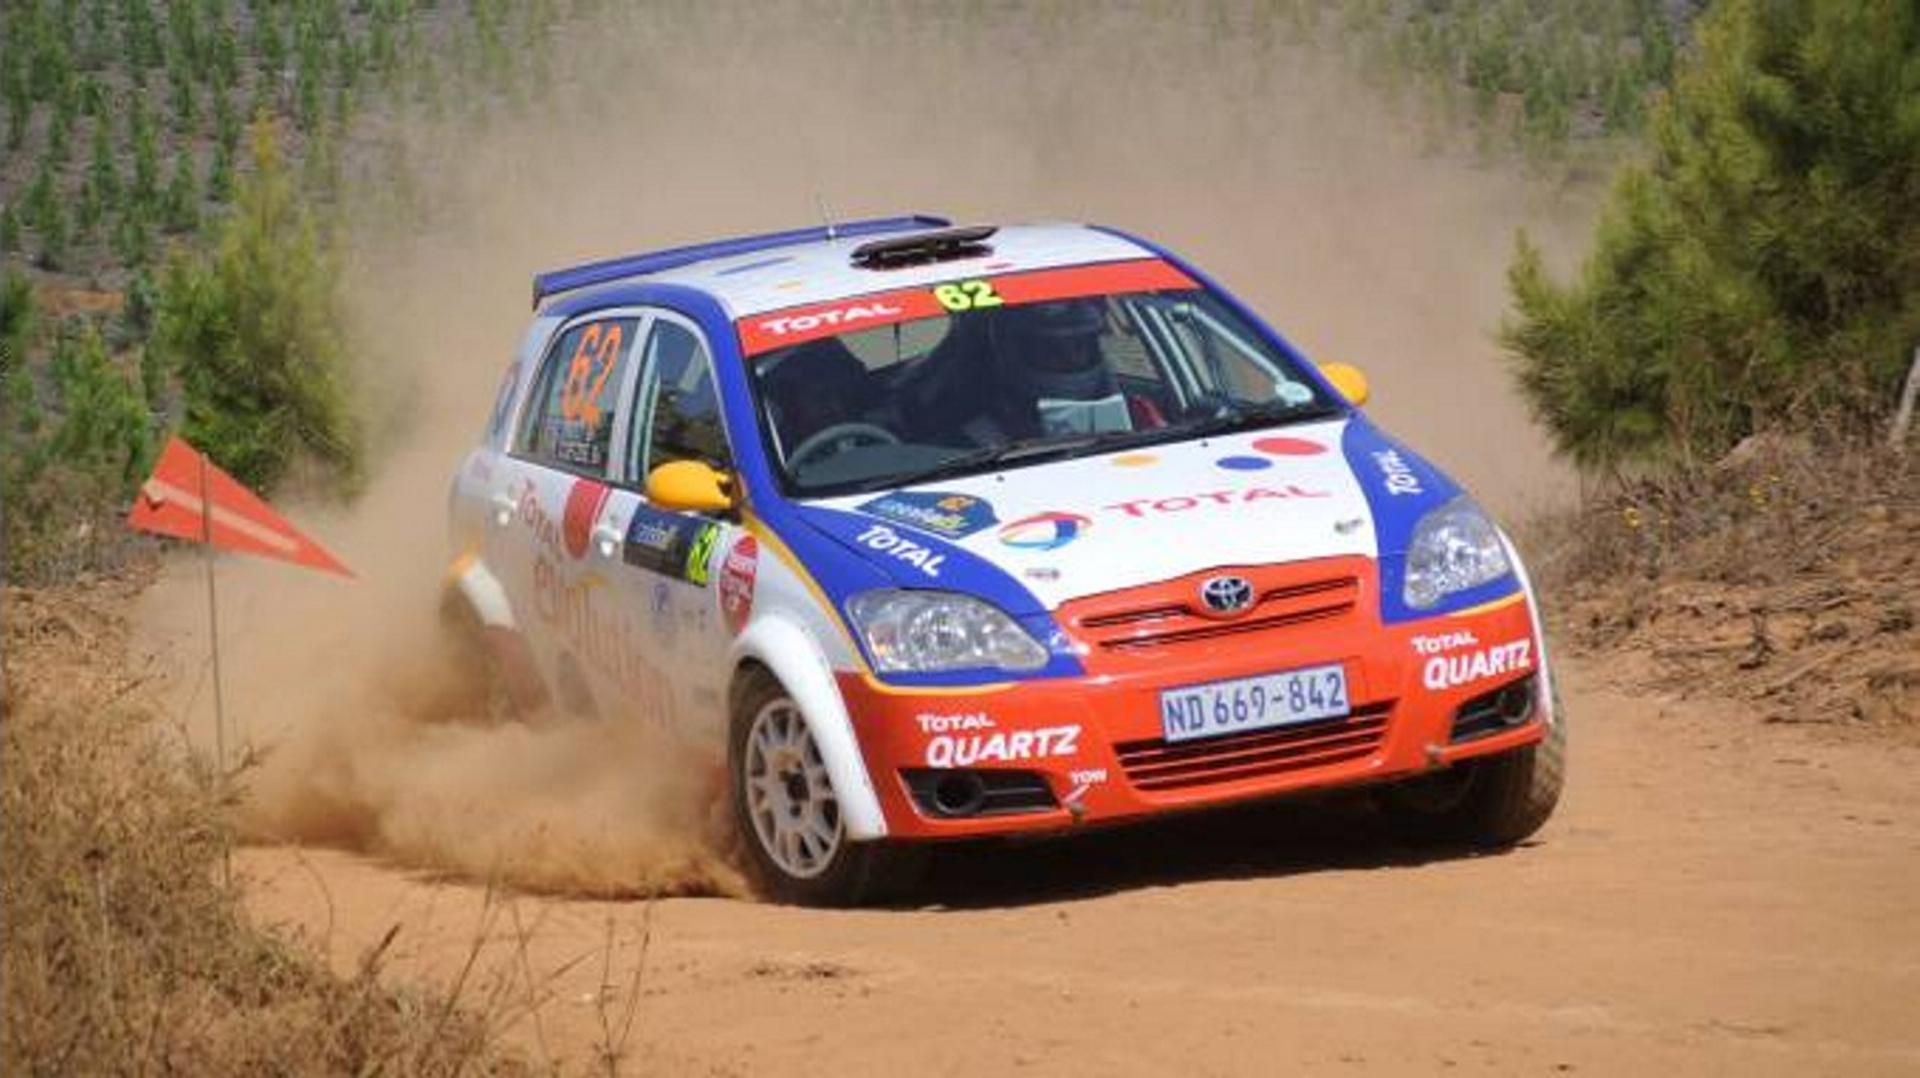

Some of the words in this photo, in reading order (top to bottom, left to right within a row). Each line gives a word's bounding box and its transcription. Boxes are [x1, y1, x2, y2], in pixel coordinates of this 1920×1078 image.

[935, 279, 1004, 312] 62
[761, 303, 901, 334] TOTAL
[561, 322, 621, 426] 62
[1372, 449, 1424, 495] TOTAL
[1104, 486, 1331, 516] TOTAL
[857, 525, 946, 577] TOTAL
[1411, 631, 1479, 655] TOTAL
[1424, 638, 1531, 690] QUARTZ
[916, 712, 996, 732] TOTAL
[1165, 694, 1204, 733] ND
[1213, 671, 1345, 726] 669-842
[927, 725, 1081, 768] QUARTZ
